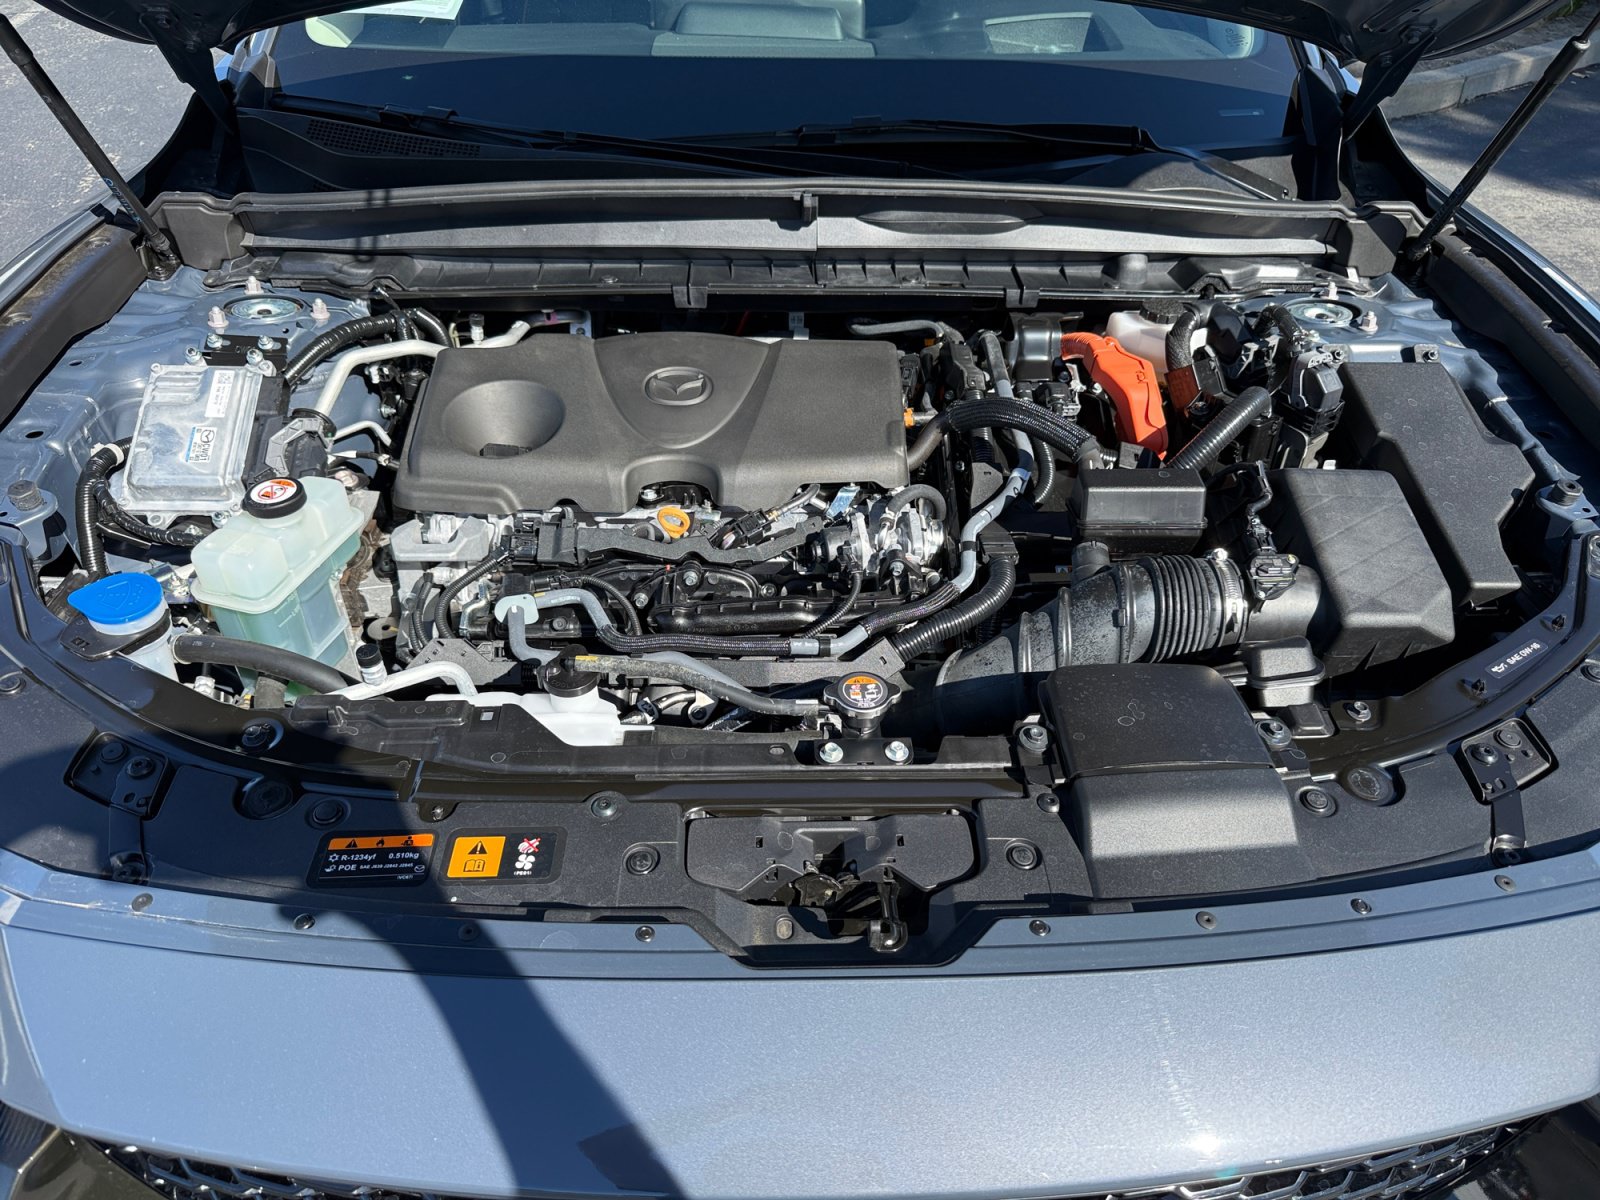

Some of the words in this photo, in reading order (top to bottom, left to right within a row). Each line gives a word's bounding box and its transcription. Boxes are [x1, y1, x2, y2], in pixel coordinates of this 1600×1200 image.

[1506, 653, 1523, 665] SAE
[340, 853, 377, 862] R-1234yf
[388, 852, 420, 860] 0.510kg
